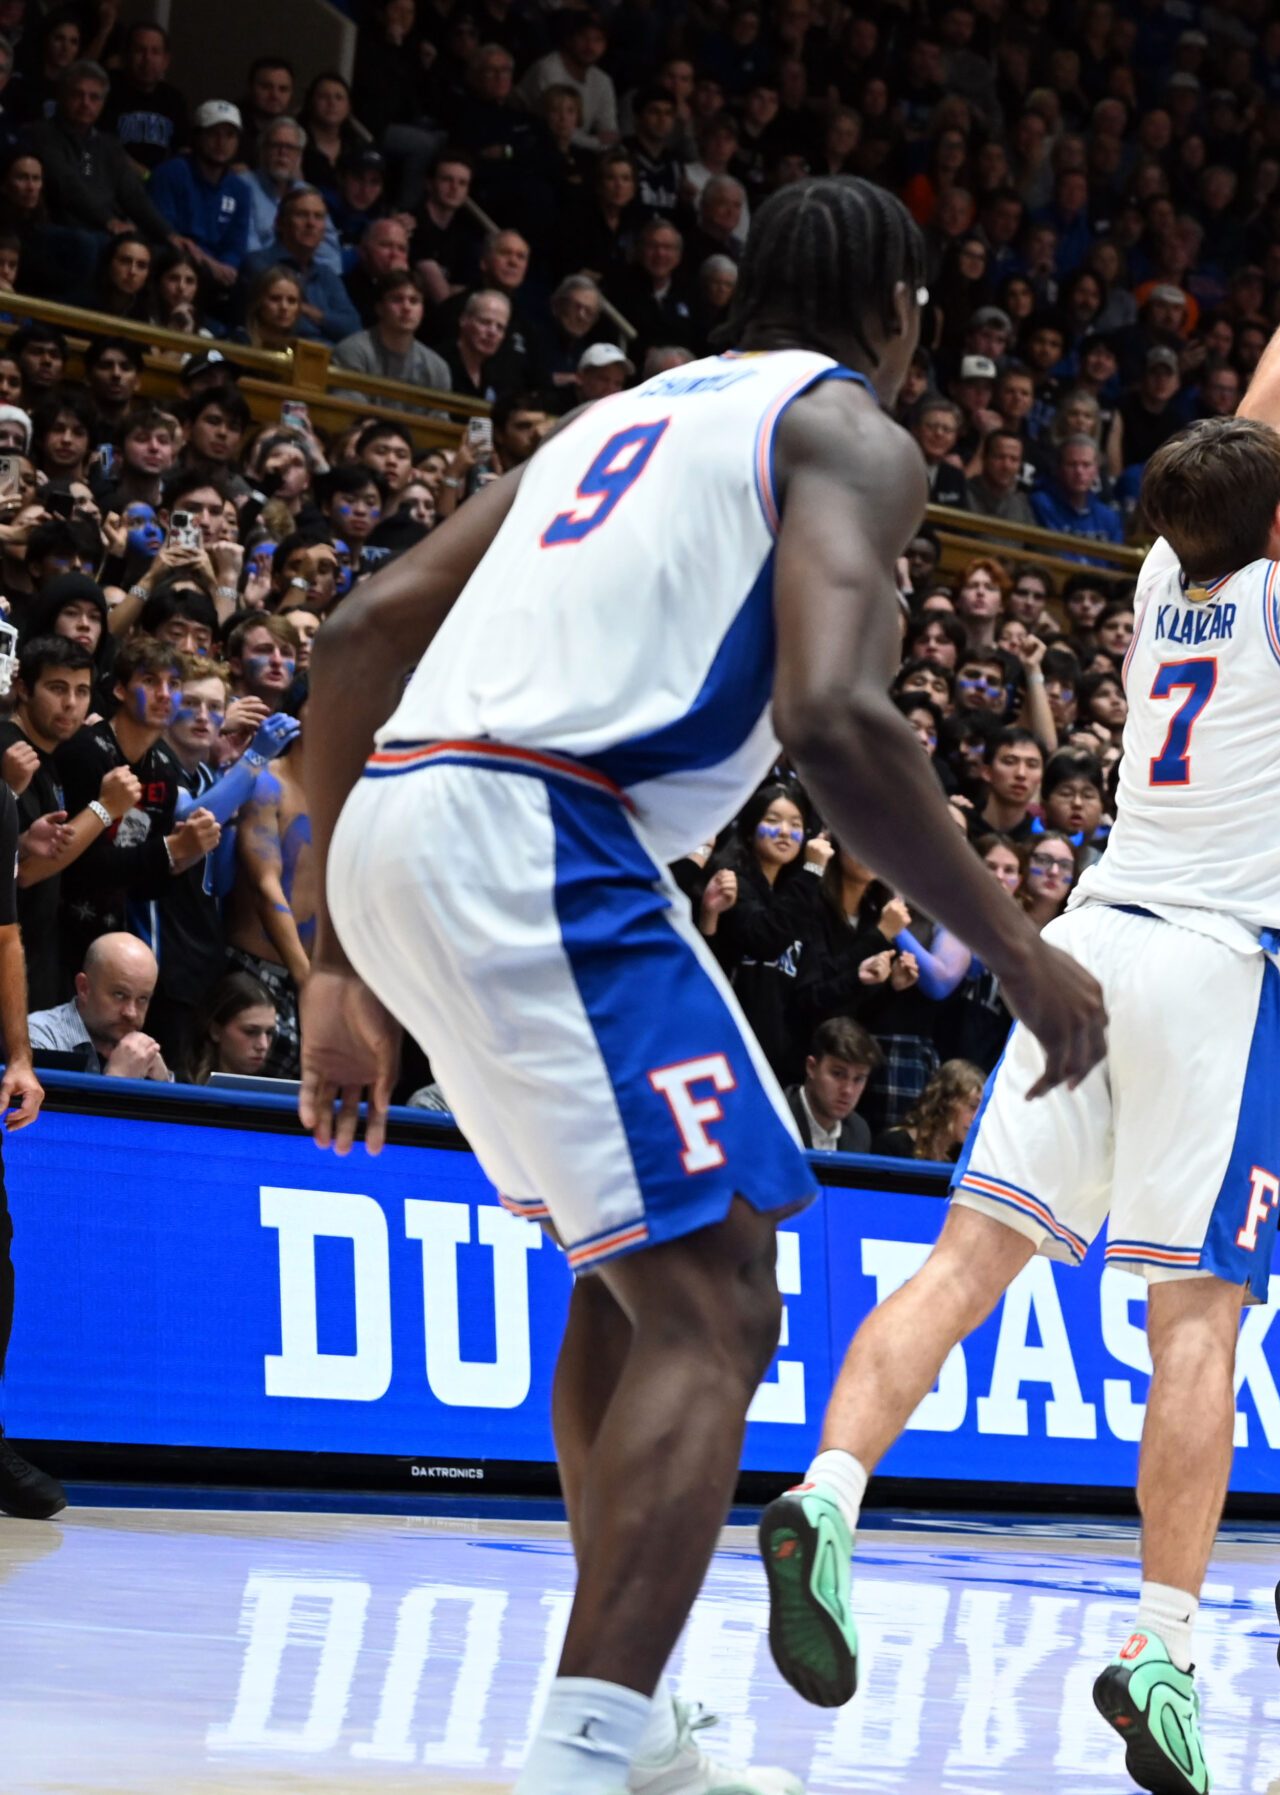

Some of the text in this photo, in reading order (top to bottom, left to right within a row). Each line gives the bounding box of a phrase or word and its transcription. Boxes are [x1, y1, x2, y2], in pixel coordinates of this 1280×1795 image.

[540, 415, 671, 549] 9
[1149, 656, 1218, 787] 7
[646, 1052, 738, 1177] F
[1234, 1164, 1280, 1253] F
[411, 1465, 484, 1479] DAKTRONICS
